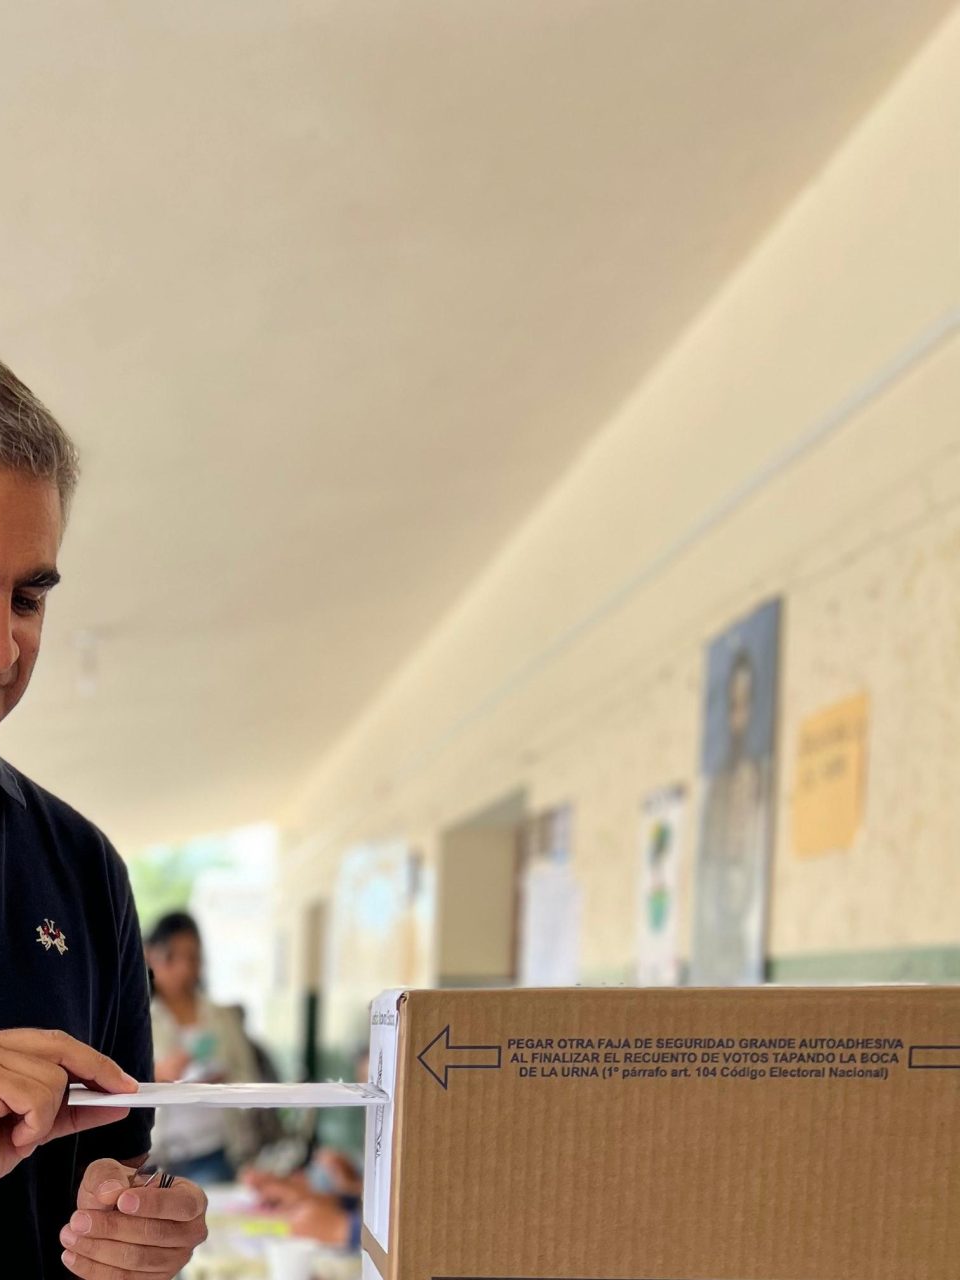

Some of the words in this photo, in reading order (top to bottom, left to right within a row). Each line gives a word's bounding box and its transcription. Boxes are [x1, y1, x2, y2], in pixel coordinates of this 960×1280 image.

[507, 1038, 554, 1049] PEGAR
[557, 1038, 594, 1049] OTRA
[597, 1038, 631, 1049] FAJA
[634, 1038, 652, 1049] DE
[655, 1038, 735, 1049] SEGURIDAD
[738, 1038, 796, 1049] GRANDE
[798, 1038, 904, 1049] AUTOADHESIVA
[510, 1053, 528, 1063] AL
[531, 1053, 600, 1063] FINALIZAR
[603, 1053, 621, 1063] EL
[623, 1053, 698, 1063] RECUENTO
[701, 1053, 719, 1063] DE
[723, 1053, 769, 1063] VOTOS
[772, 1053, 836, 1063] TAPANDO
[839, 1053, 856, 1063] LA
[860, 1053, 899, 1063] BOCA
[519, 1067, 537, 1077] DE
[541, 1067, 557, 1077] LA
[561, 1067, 599, 1077] URNA
[622, 1066, 668, 1079] párrafo
[670, 1067, 691, 1077] art.
[695, 1067, 717, 1077] 104
[720, 1066, 766, 1080] Código
[769, 1067, 825, 1078] Electoral
[828, 1067, 889, 1080] Nacional)
